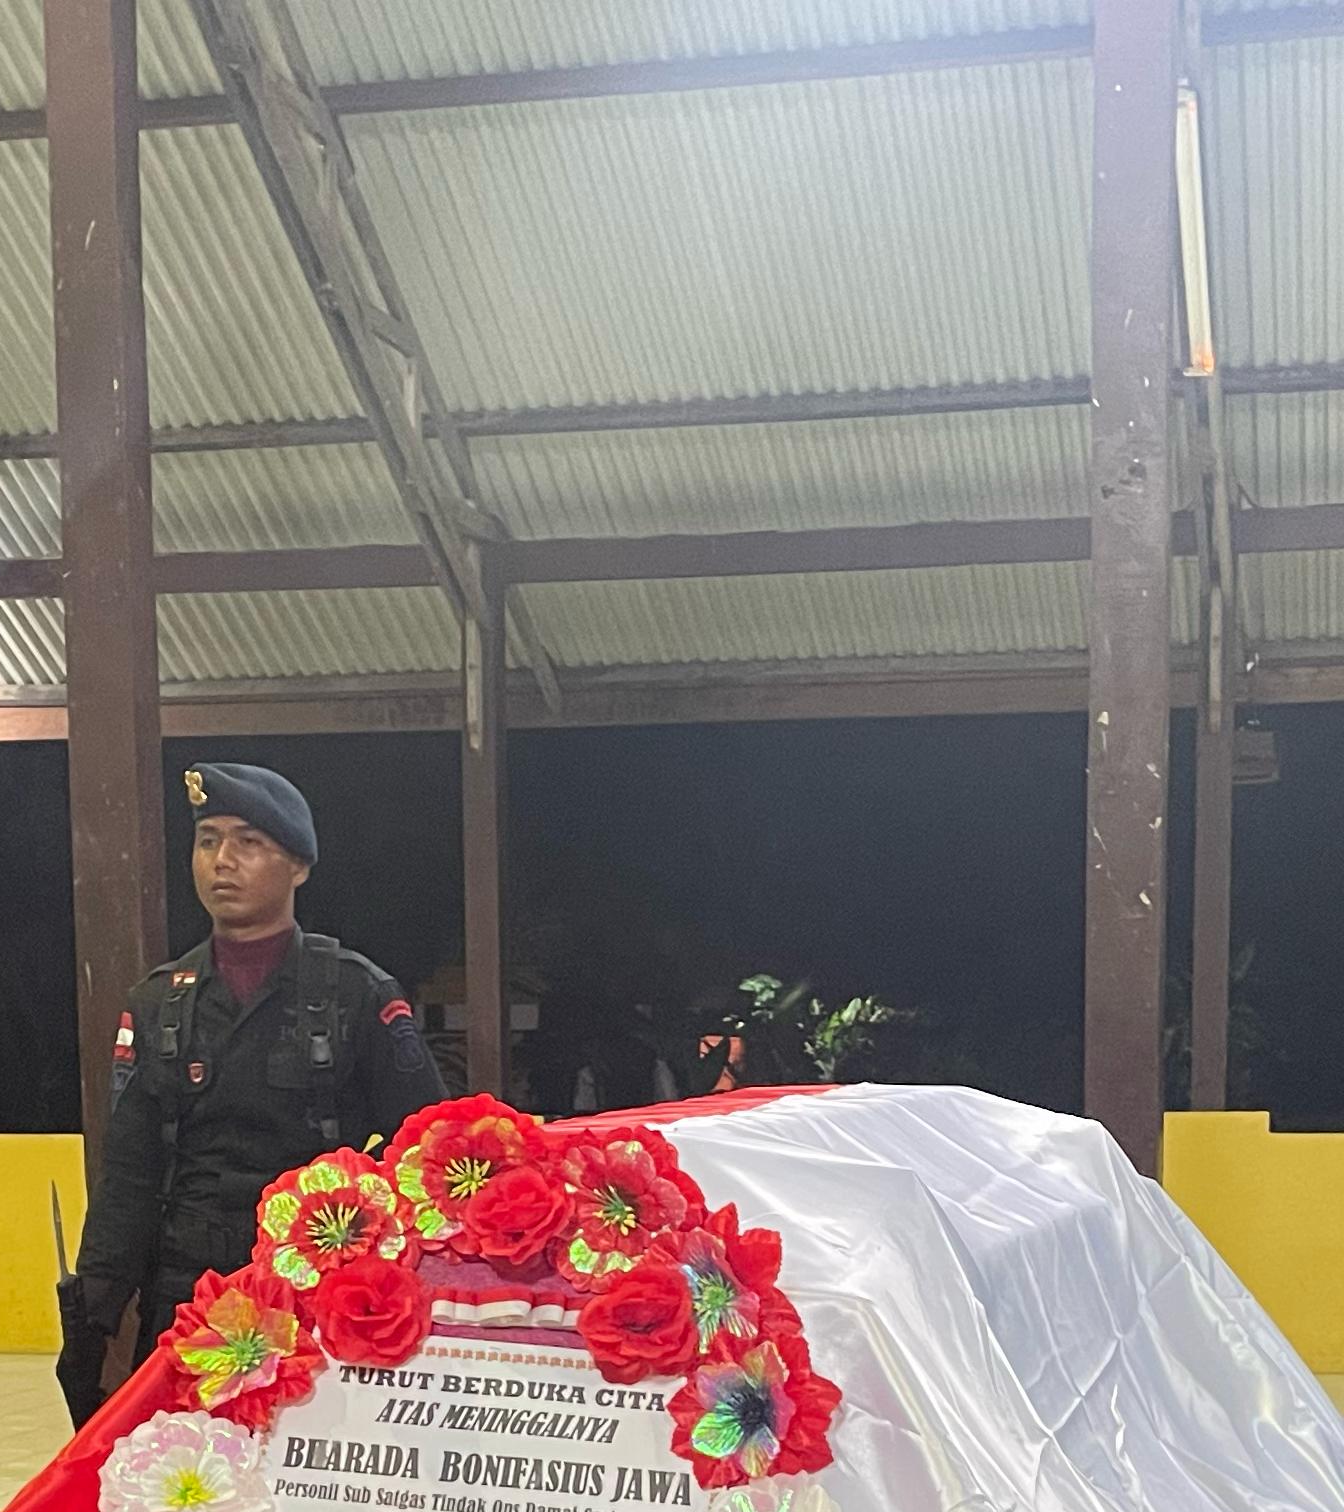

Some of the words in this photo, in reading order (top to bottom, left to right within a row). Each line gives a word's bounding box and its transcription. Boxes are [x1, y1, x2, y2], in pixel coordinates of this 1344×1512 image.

[339, 1365, 435, 1390] TURUT
[440, 1374, 586, 1405] BERDUKA
[595, 1389, 665, 1412] CITA
[375, 1398, 441, 1428] ATAS
[439, 1402, 620, 1444] MENINGGALNYA
[274, 1479, 339, 1501] Personil
[343, 1485, 371, 1504] Sub
[376, 1488, 426, 1510] Satgas
[438, 1450, 605, 1497] BONIFASIUS
[609, 1467, 691, 1506] JAWA
